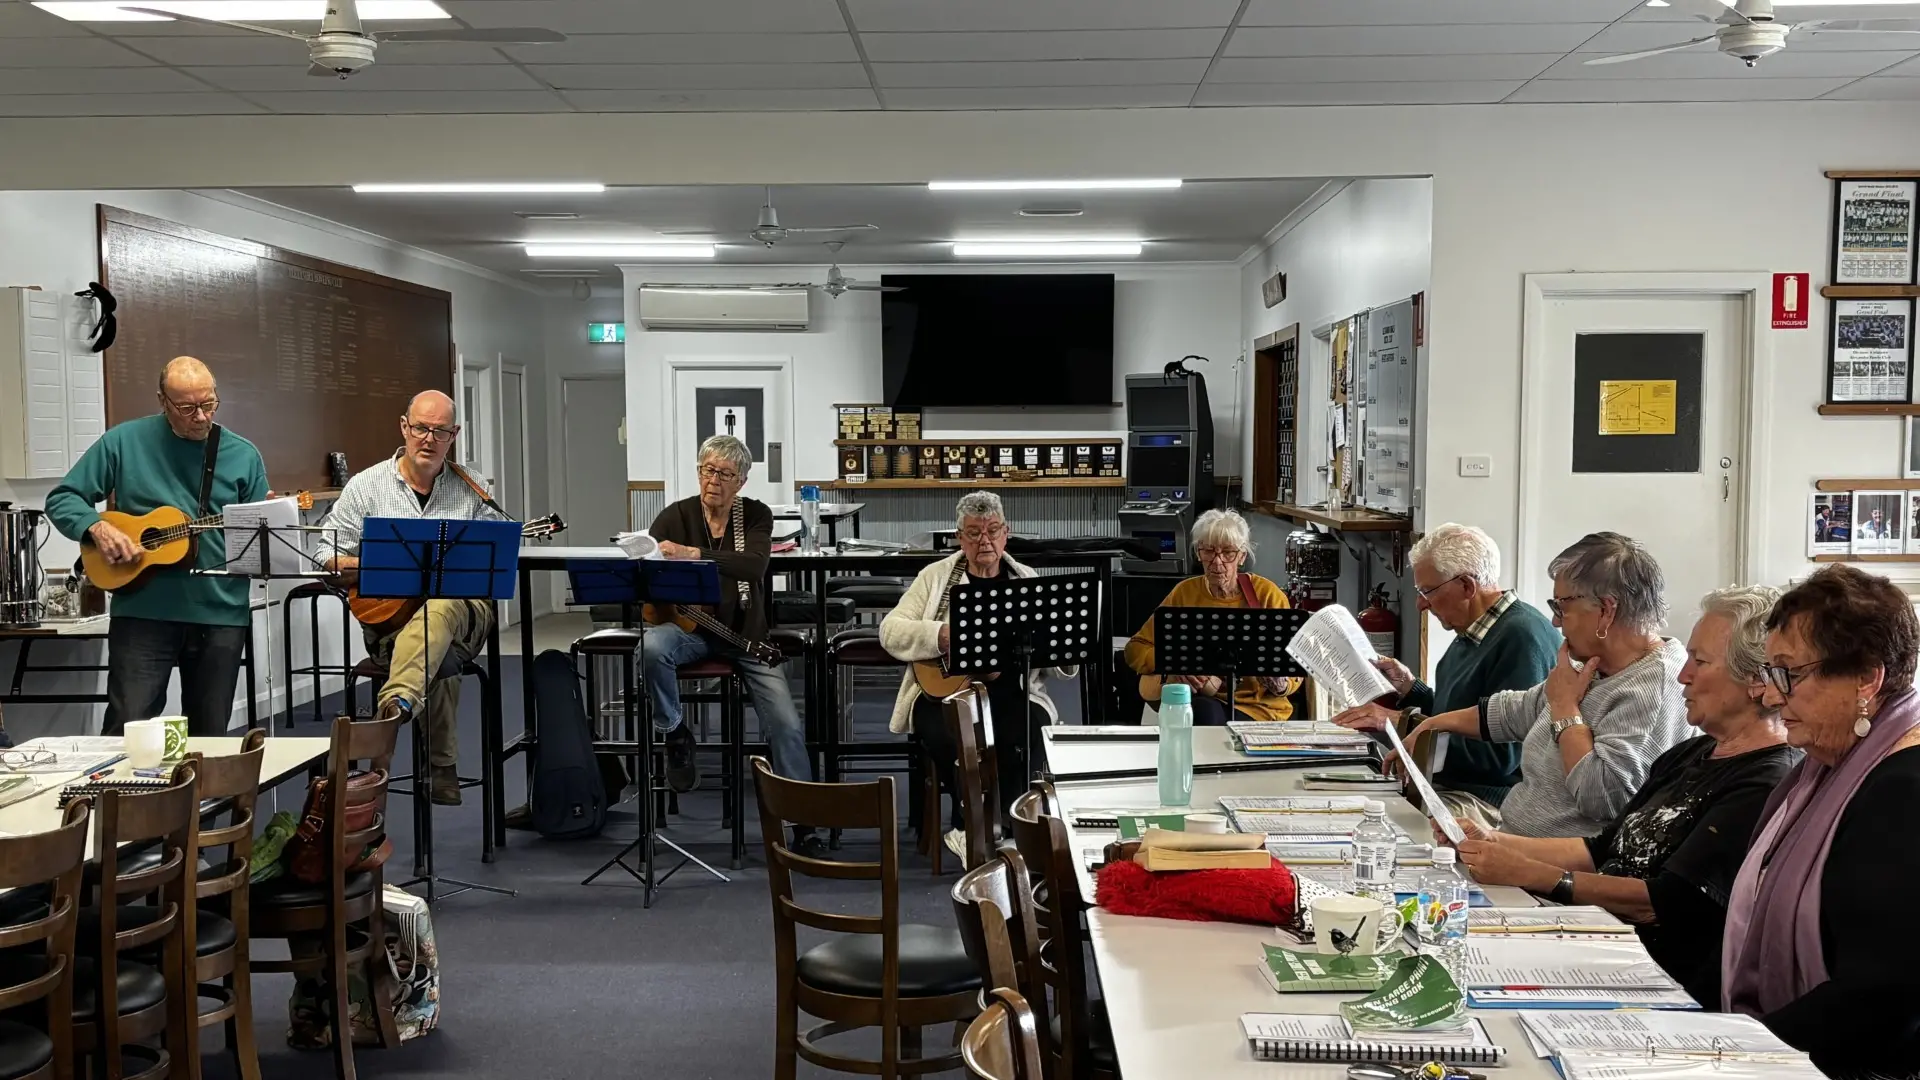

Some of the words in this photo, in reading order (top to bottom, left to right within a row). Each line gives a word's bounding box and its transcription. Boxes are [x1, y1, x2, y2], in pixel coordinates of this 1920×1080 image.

[1881, 190, 1905, 198] Final
[1382, 981, 1411, 1002] LARGE
[1409, 956, 1429, 985] PRINT
[1400, 981, 1425, 1001] BOOK
[1419, 1002, 1453, 1020] RESOURCES
